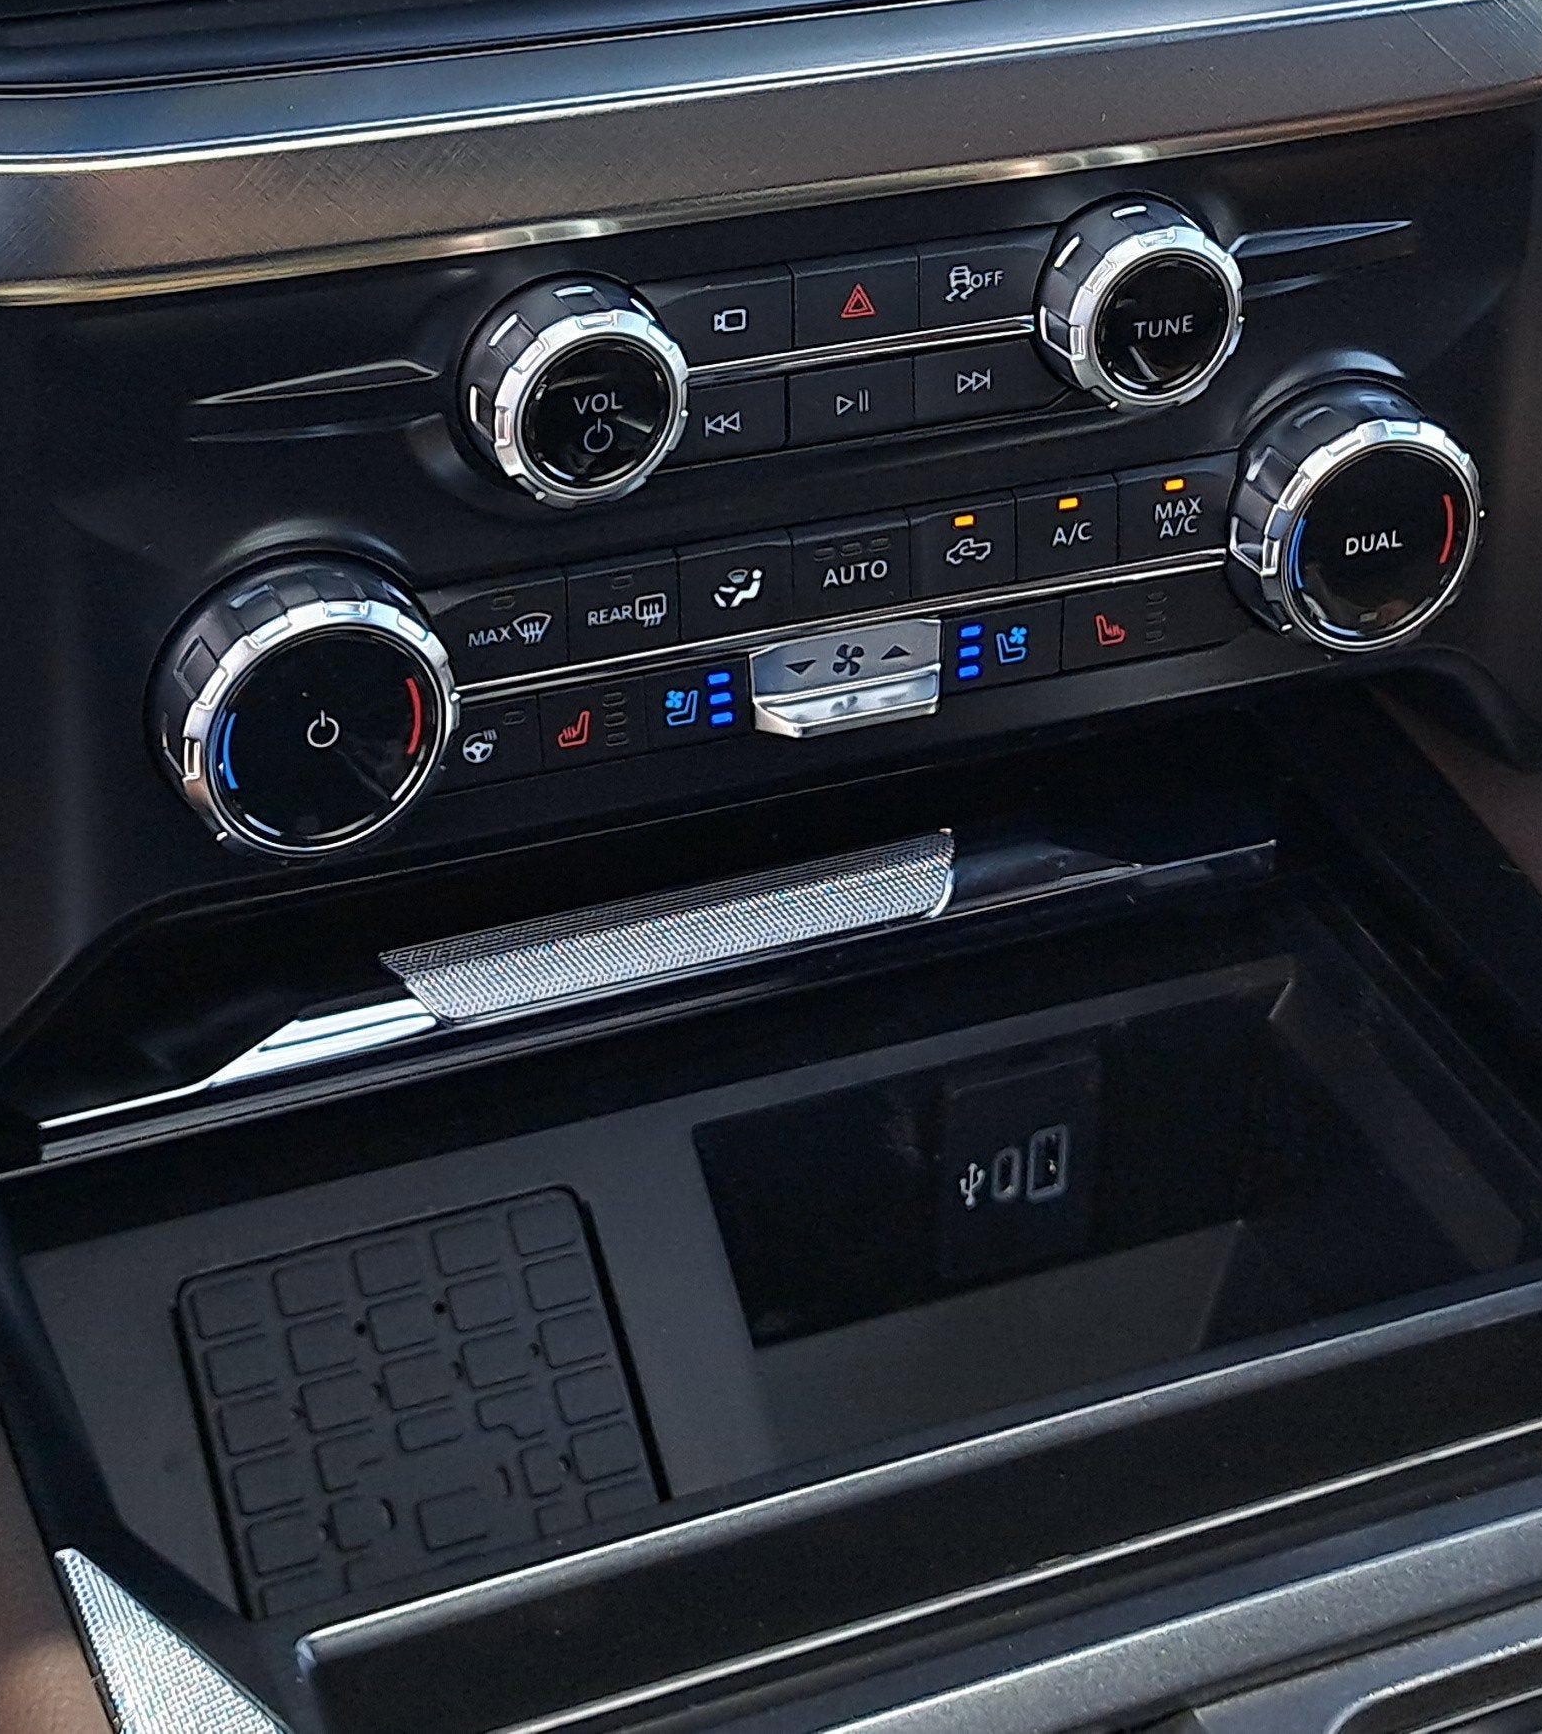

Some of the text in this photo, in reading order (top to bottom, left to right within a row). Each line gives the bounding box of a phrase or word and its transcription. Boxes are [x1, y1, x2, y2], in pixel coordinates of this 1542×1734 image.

[970, 270, 1005, 289] OFF
[1133, 314, 1195, 340] TUNE
[572, 394, 623, 415] VOL
[1154, 496, 1203, 524] MAX
[1051, 521, 1094, 547] A/C
[1159, 515, 1200, 540] A/C
[1344, 529, 1404, 557] DUAL
[821, 559, 889, 589] AUTO
[587, 604, 633, 627] REAR
[467, 625, 514, 649] MAX
